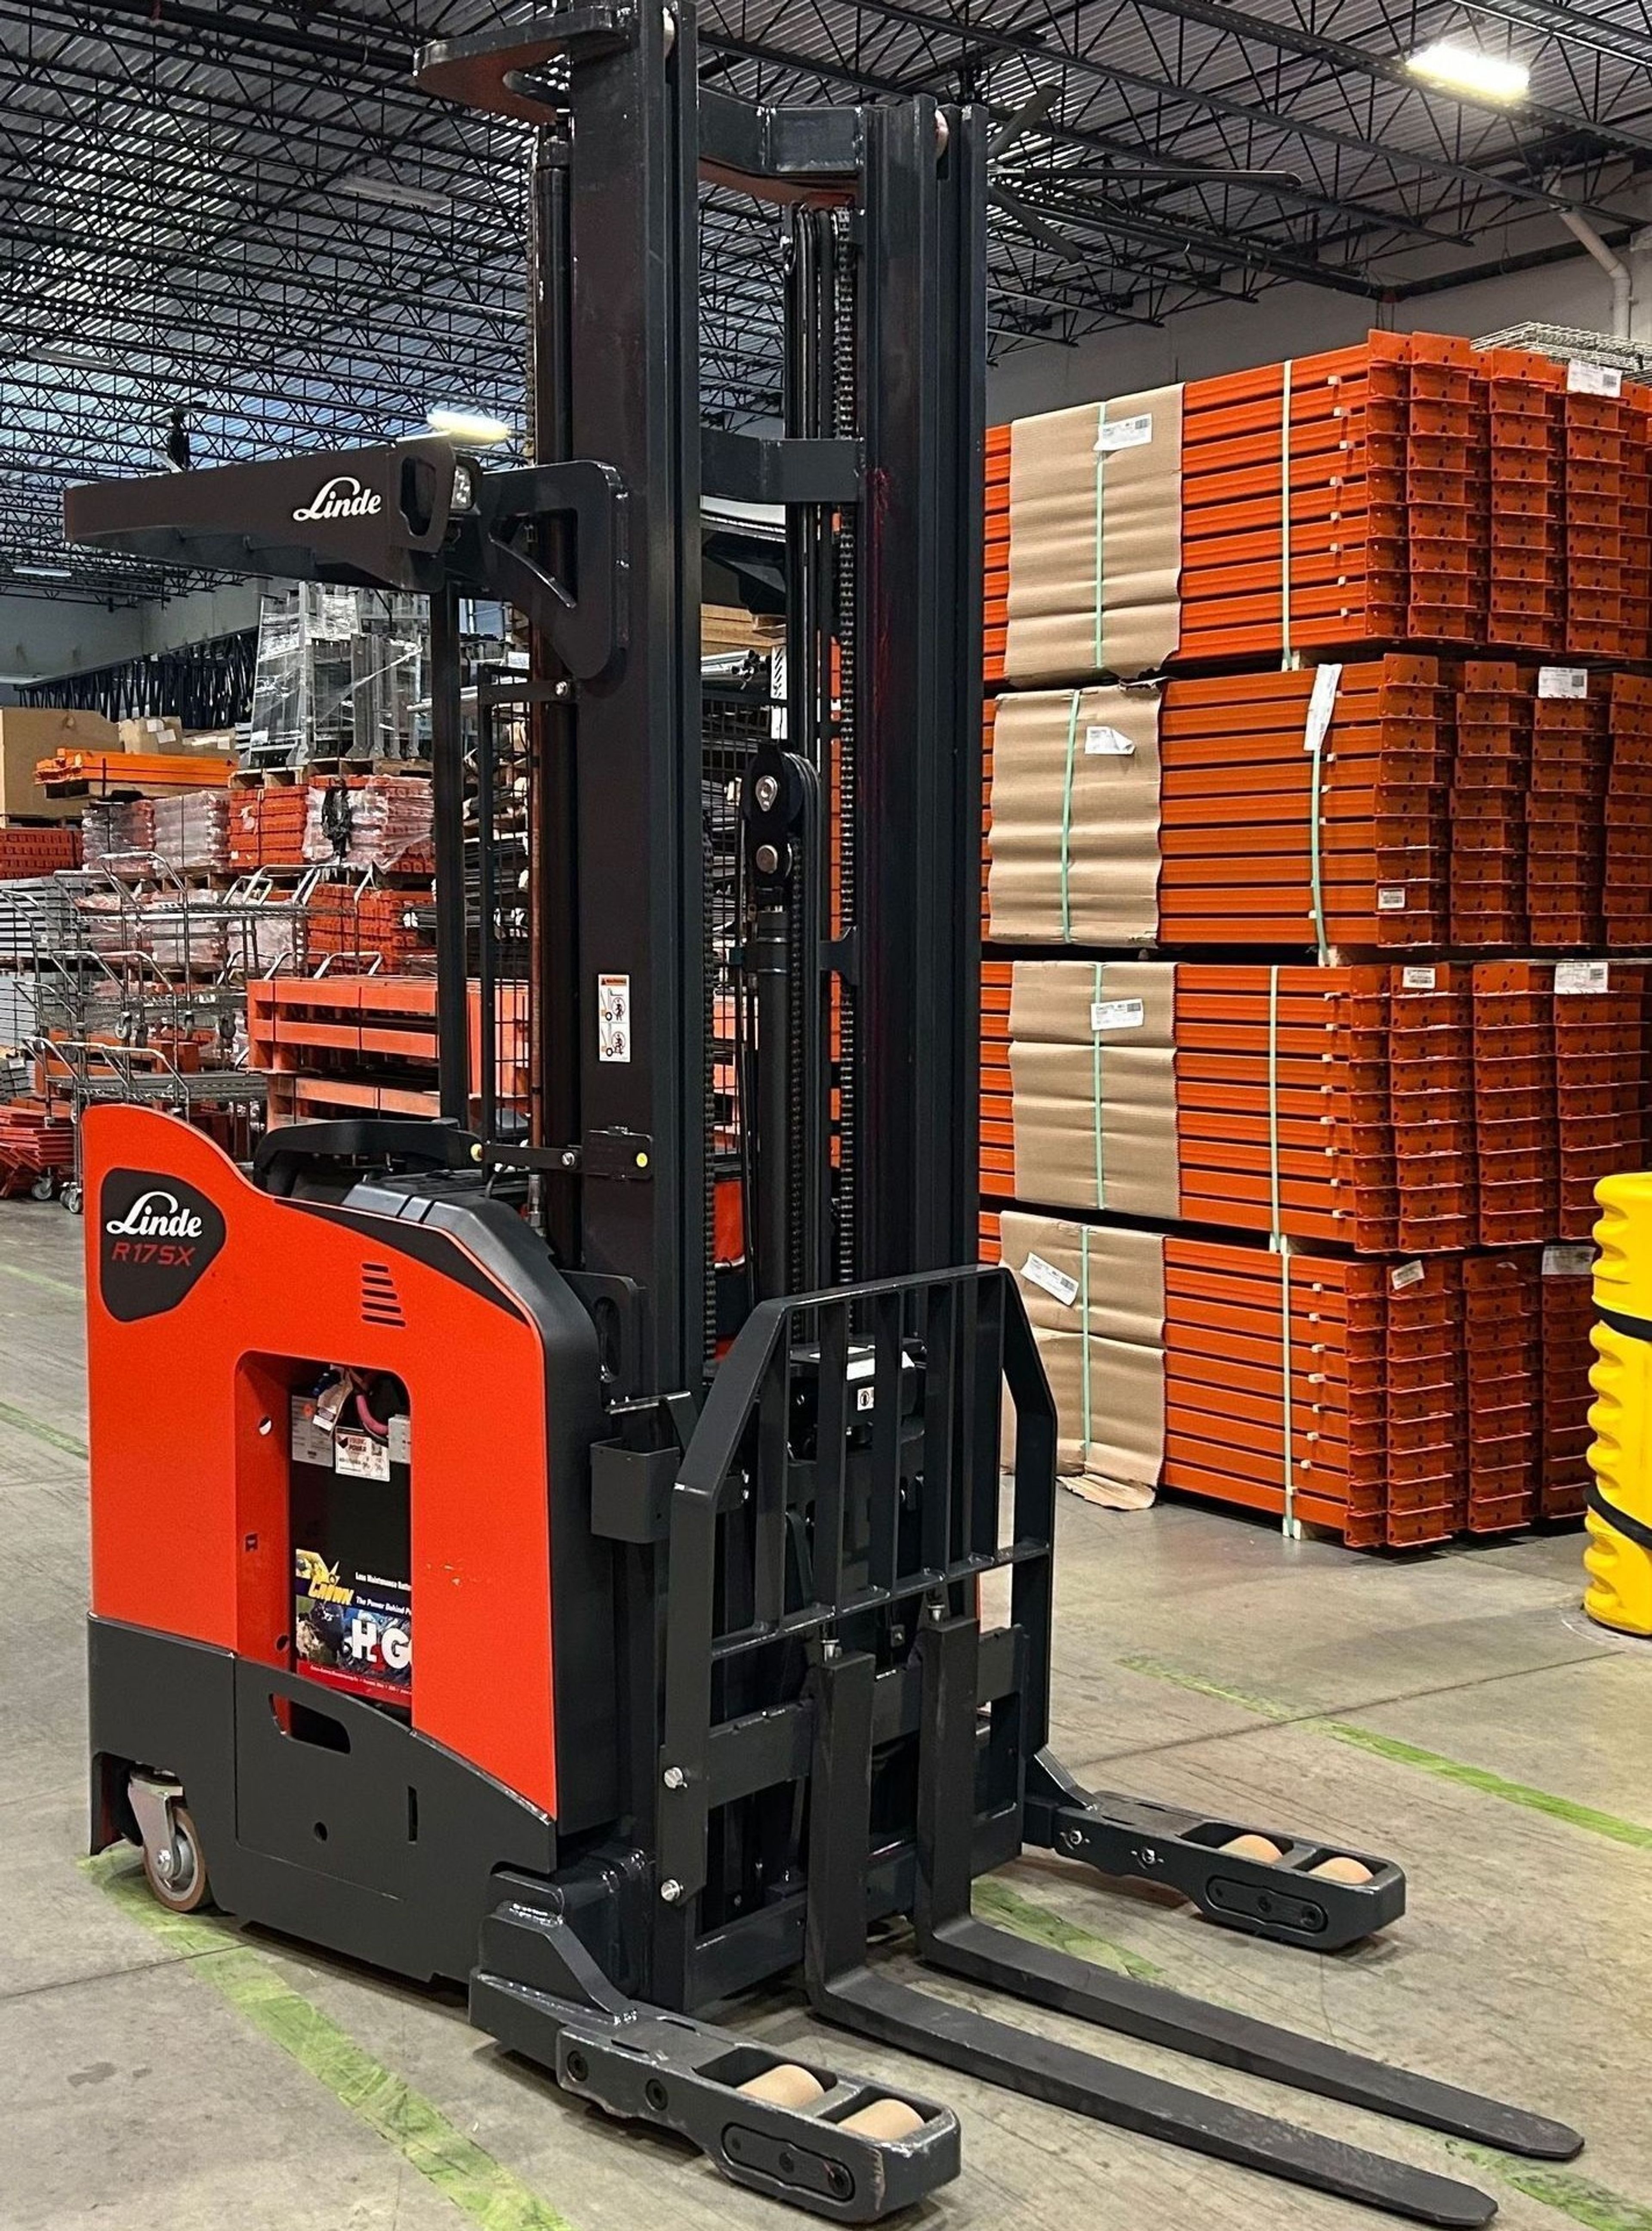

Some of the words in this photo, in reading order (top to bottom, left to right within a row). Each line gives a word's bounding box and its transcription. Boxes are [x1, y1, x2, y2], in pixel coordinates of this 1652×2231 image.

[293, 476, 382, 521] Linde
[106, 1191, 203, 1237] Linde
[367, 1598, 385, 1609] Power
[385, 1602, 405, 1614] Behind
